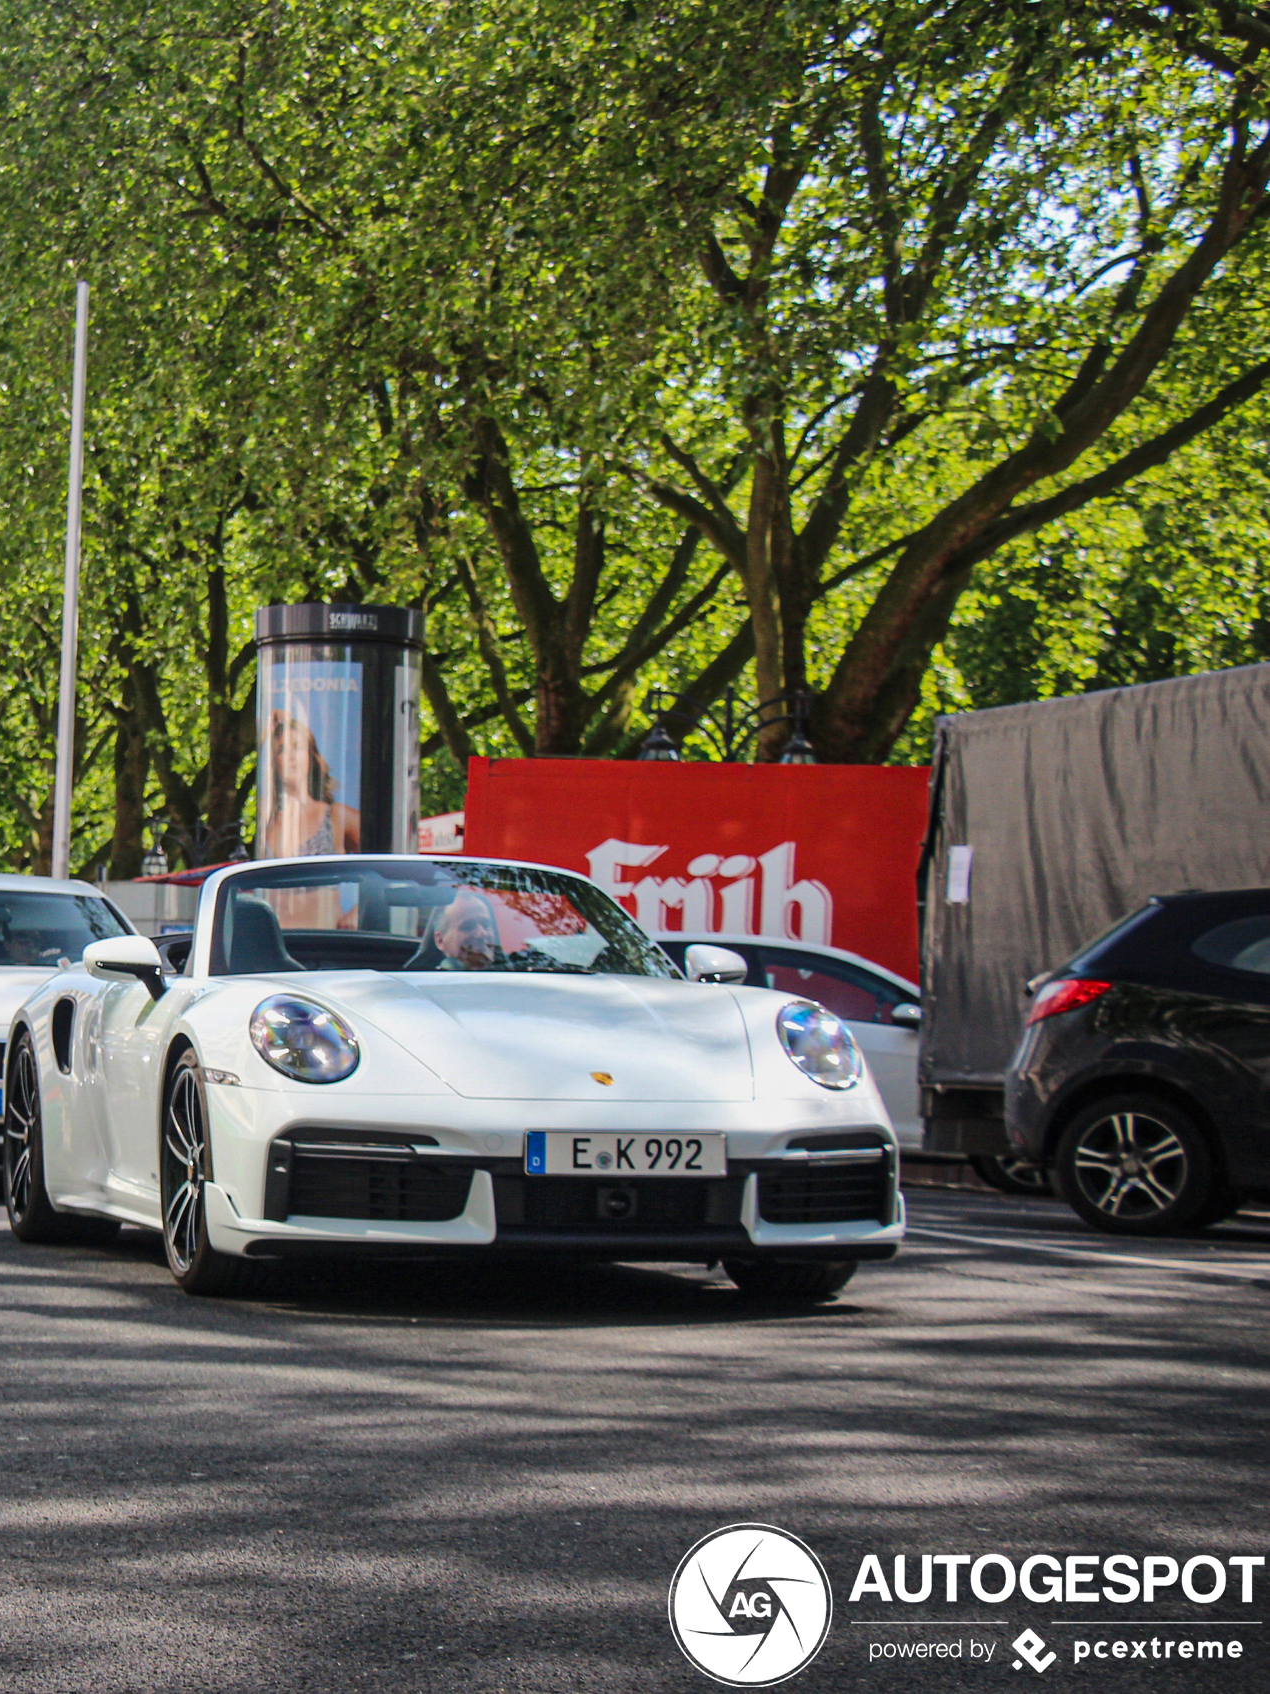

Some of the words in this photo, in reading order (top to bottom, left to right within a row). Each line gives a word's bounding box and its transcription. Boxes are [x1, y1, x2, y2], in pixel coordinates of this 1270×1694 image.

[585, 838, 833, 946] Früh
[572, 1138, 592, 1169] E
[616, 1138, 636, 1169] K
[645, 1138, 703, 1170] 992
